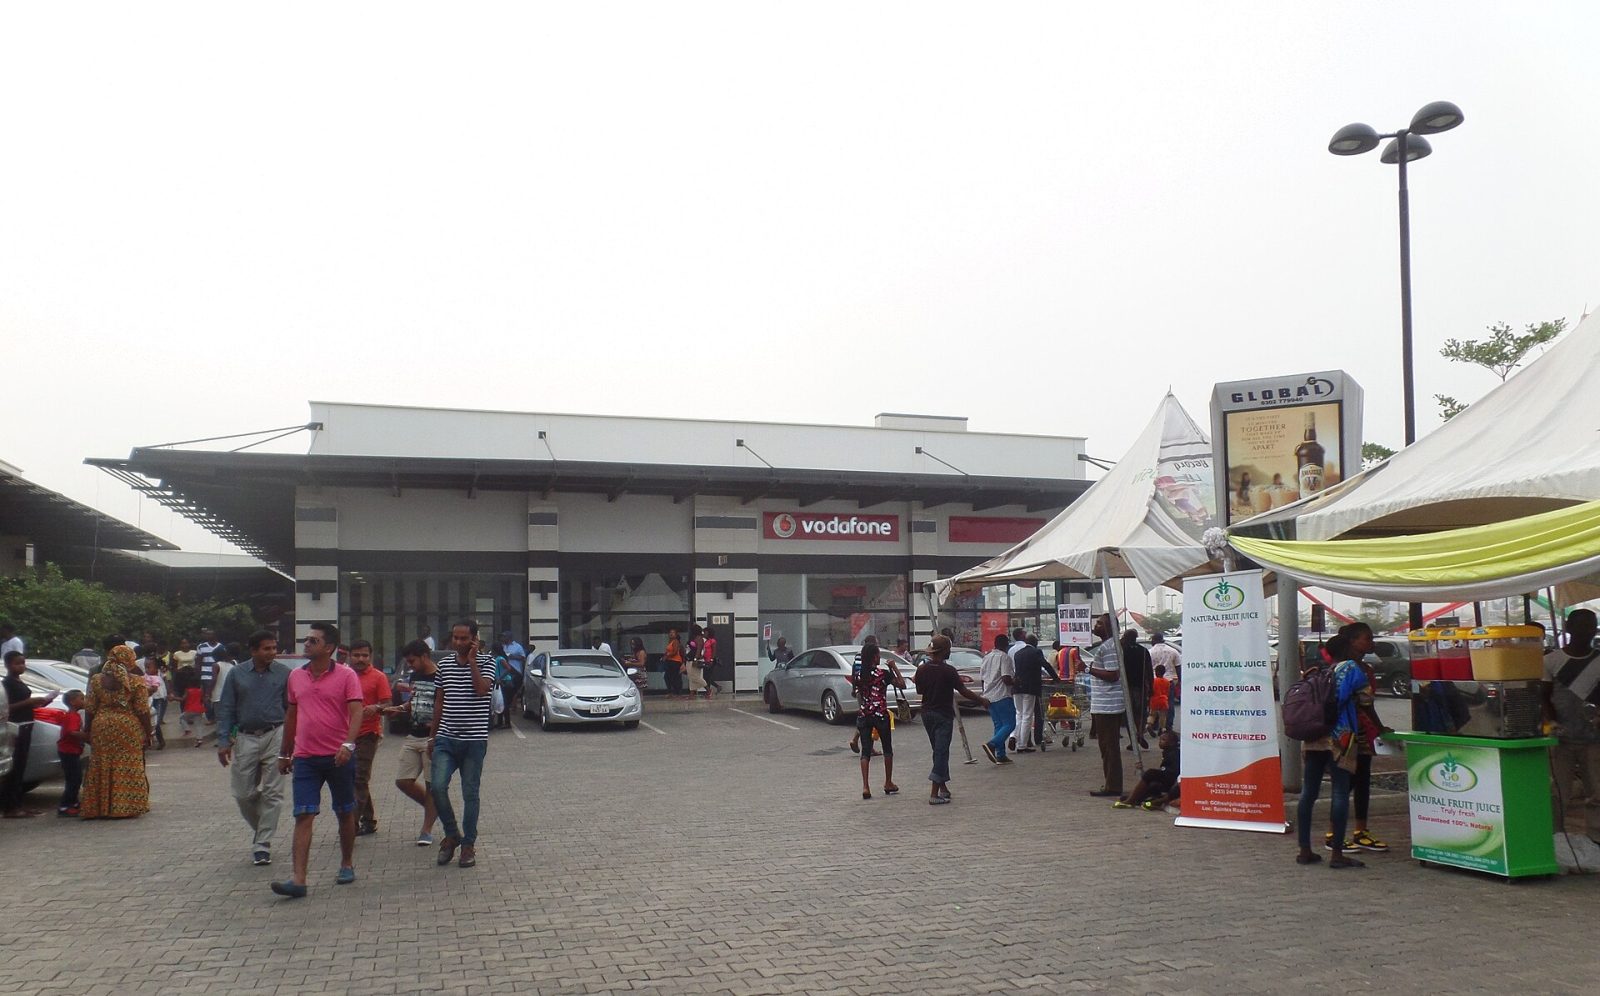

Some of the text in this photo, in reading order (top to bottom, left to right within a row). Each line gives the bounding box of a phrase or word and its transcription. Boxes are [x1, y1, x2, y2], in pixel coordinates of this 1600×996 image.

[1231, 384, 1323, 403] GLOBAL
[1241, 423, 1286, 433] TOGETHER
[802, 516, 892, 535] vodafone
[1191, 612, 1259, 622] NATURAL FRUIT JUICE
[1212, 733, 1267, 741] PASTEURIZED
[1410, 794, 1501, 813] NATURAL FRUIT JUICE
[1441, 807, 1456, 816] Truly
[1458, 809, 1475, 817] fresh
[1451, 819, 1469, 827] 100%
[1470, 822, 1494, 831] Natural
